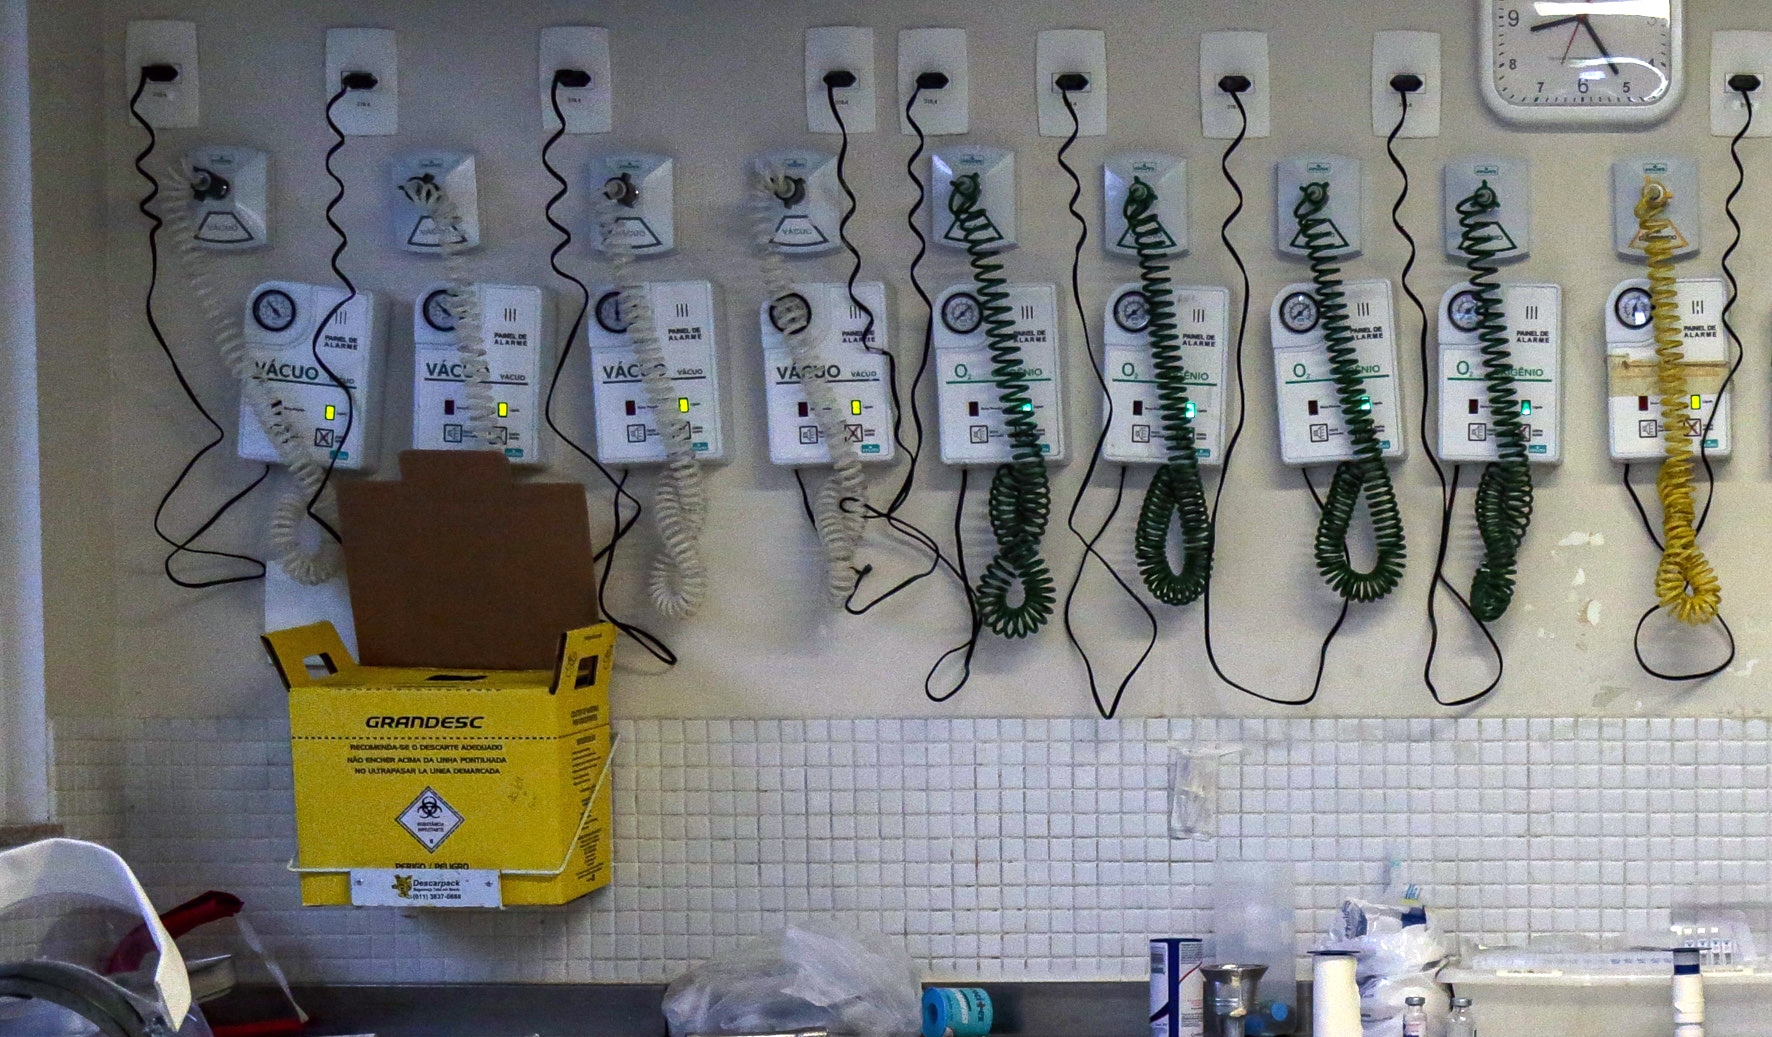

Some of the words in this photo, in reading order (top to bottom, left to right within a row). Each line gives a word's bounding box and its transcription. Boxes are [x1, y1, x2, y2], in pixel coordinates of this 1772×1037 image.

[1508, 10, 1520, 27] 9
[1508, 58, 1517, 70] 8
[1537, 82, 1545, 93] 7
[1578, 79, 1589, 94] 6
[1622, 82, 1631, 93] 5
[677, 367, 703, 377] VÁCUO
[366, 716, 485, 729] GRANDESC
[413, 880, 460, 888] Descarpack
